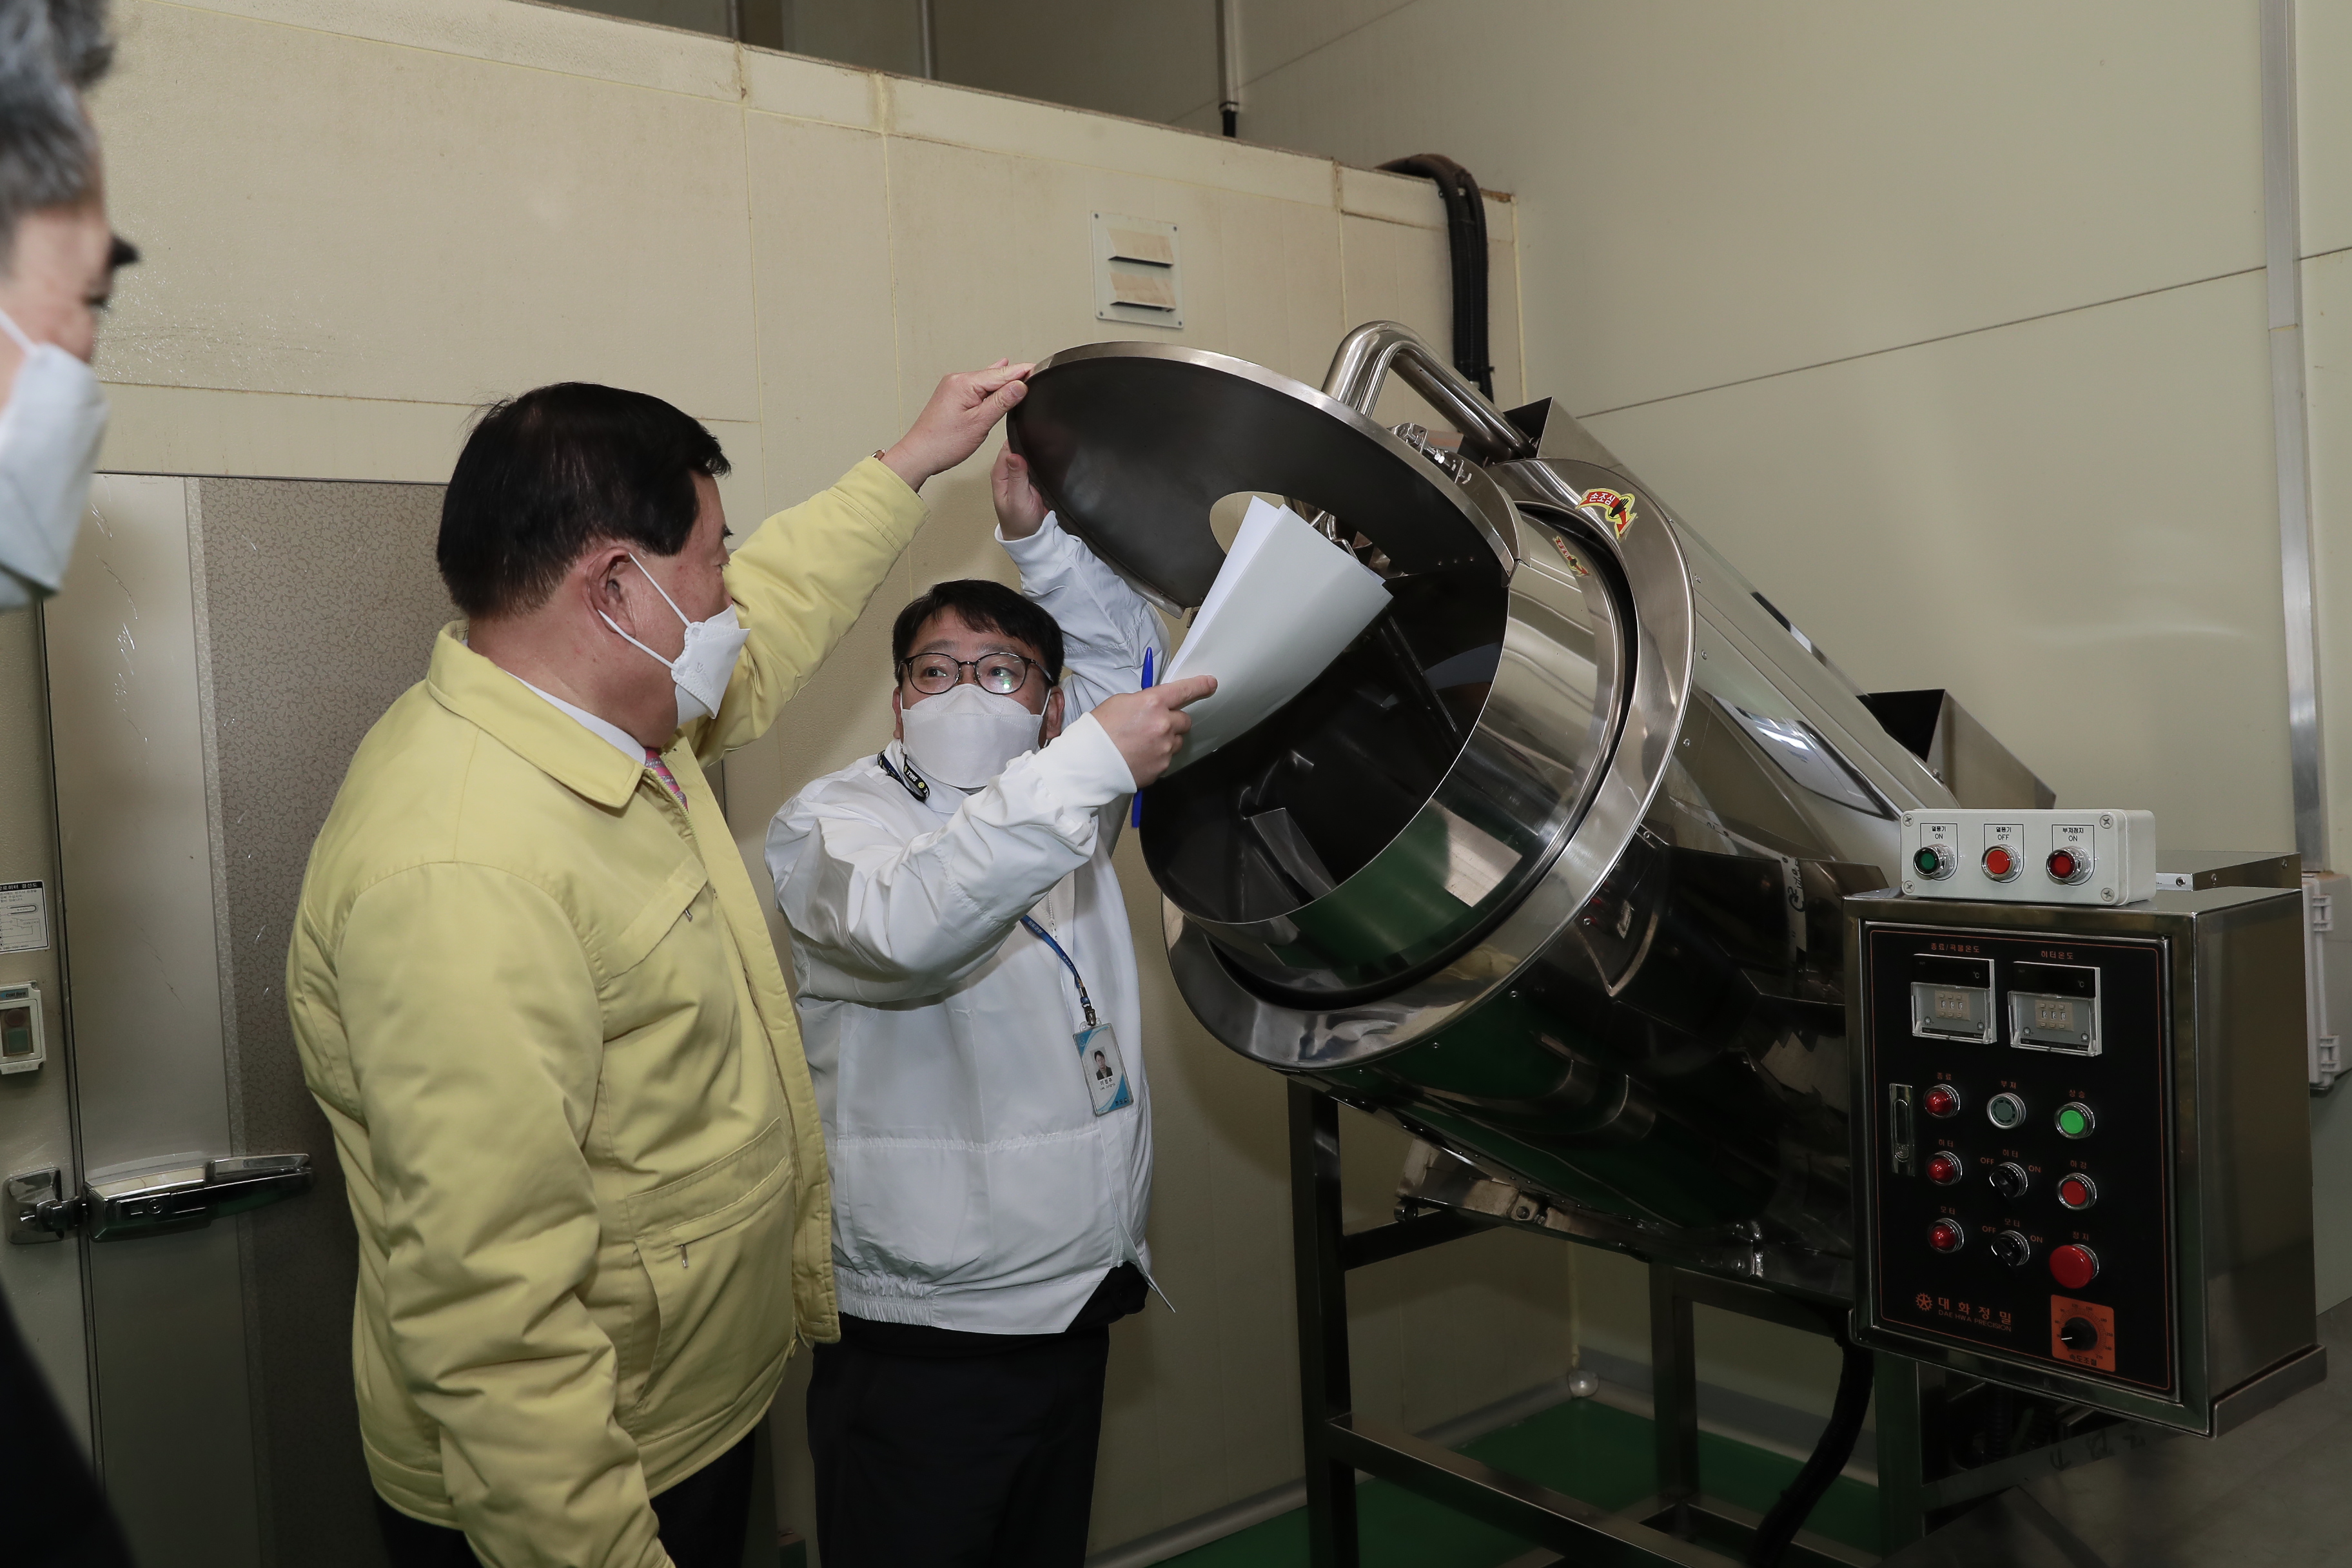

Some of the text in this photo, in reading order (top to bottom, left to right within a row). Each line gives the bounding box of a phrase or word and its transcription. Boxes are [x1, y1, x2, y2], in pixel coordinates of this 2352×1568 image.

[1589, 493, 1616, 505] 손조심
[906, 769, 918, 782] SMILE
[2068, 1089, 2086, 1099] 상승
[1980, 1157, 1995, 1165] OFF
[2070, 1160, 2087, 1170] 하강
[2028, 1165, 2041, 1173] ON
[1940, 1206, 1955, 1215] 모터
[2004, 1218, 2020, 1228] 모터
[1982, 1226, 1997, 1234] OFF
[2030, 1235, 2043, 1243] ON
[2072, 1231, 2090, 1241] 정지
[1938, 1309, 2012, 1332] DAE HWA PRECISION
